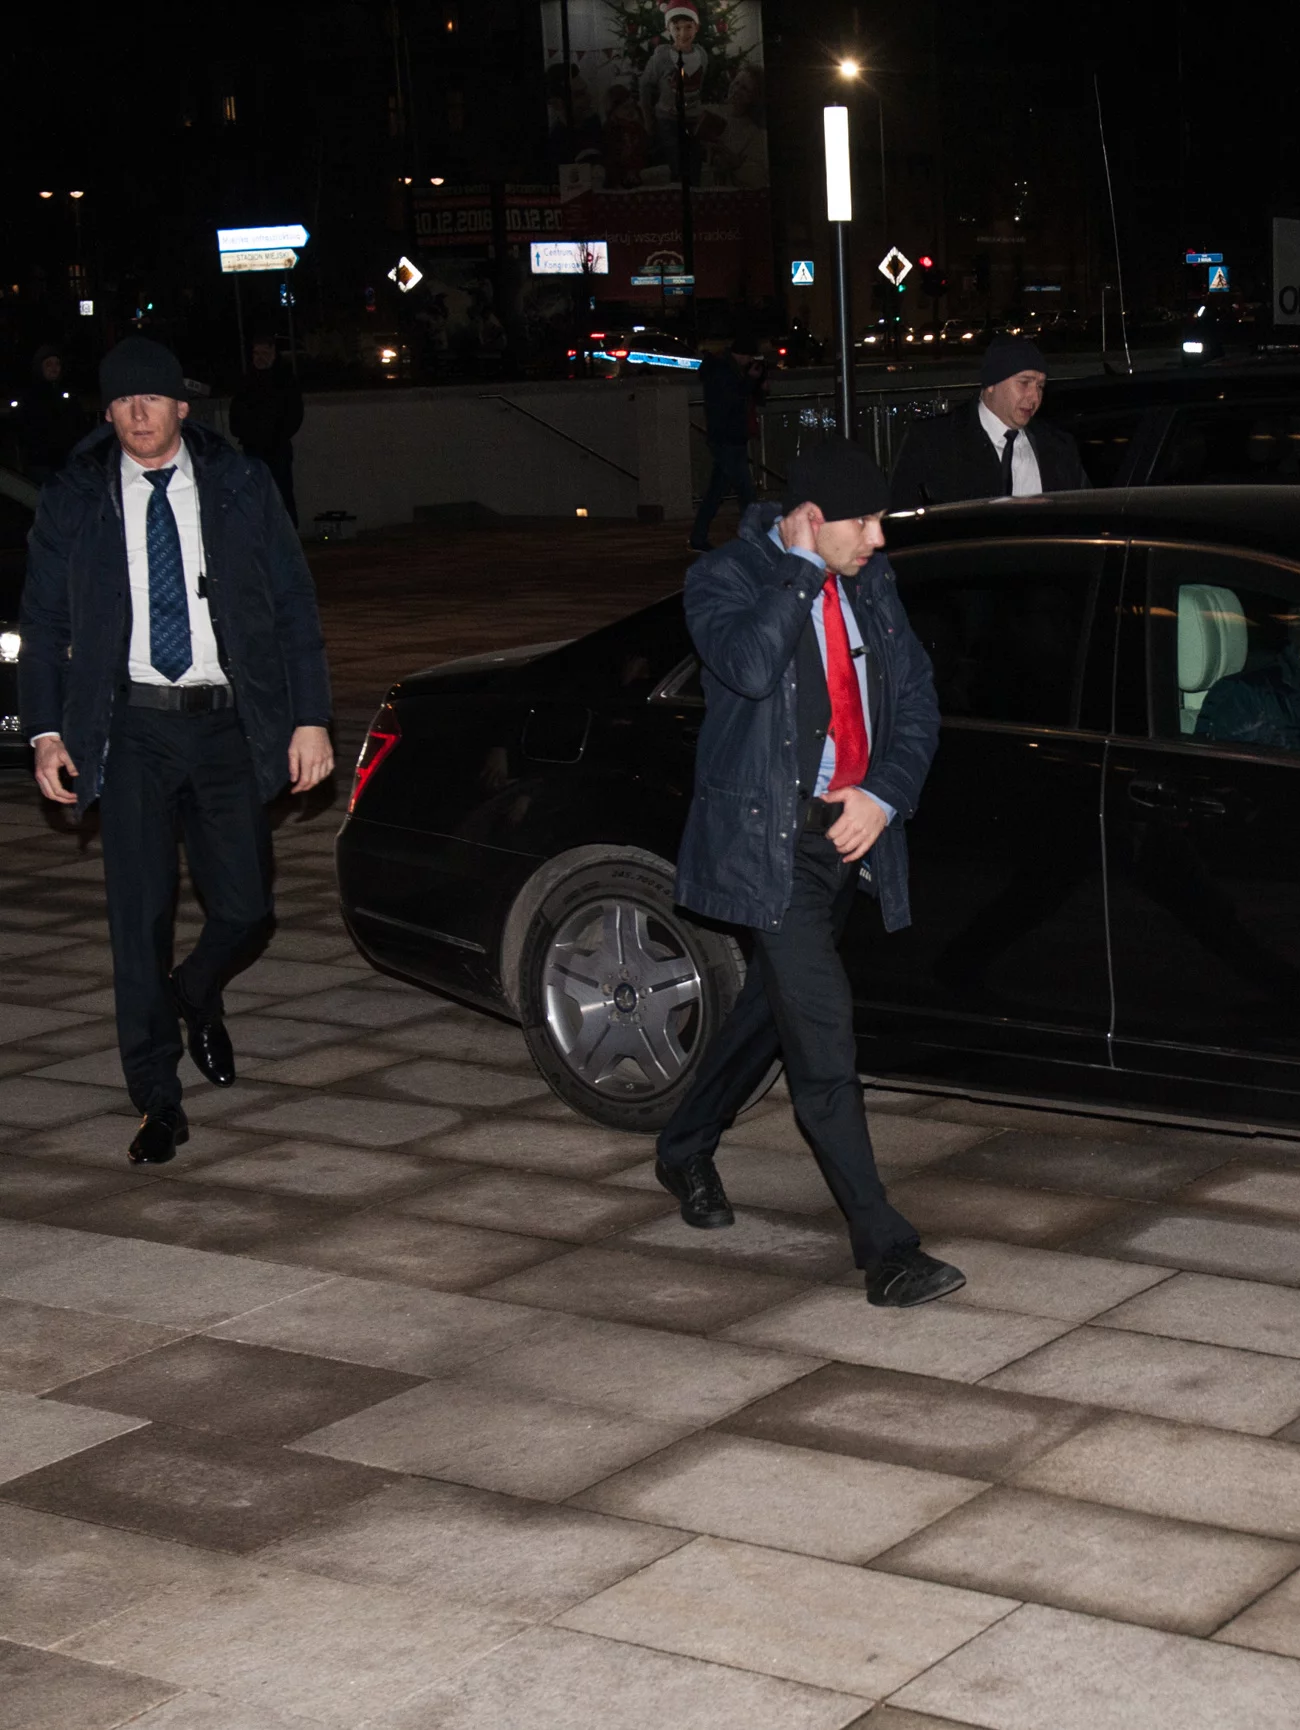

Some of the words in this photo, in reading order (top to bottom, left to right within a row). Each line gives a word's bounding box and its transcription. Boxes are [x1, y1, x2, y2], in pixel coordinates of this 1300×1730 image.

[505, 208, 564, 232] 10.12.20
[634, 228, 697, 246] wszystk
[236, 253, 264, 262] STADION
